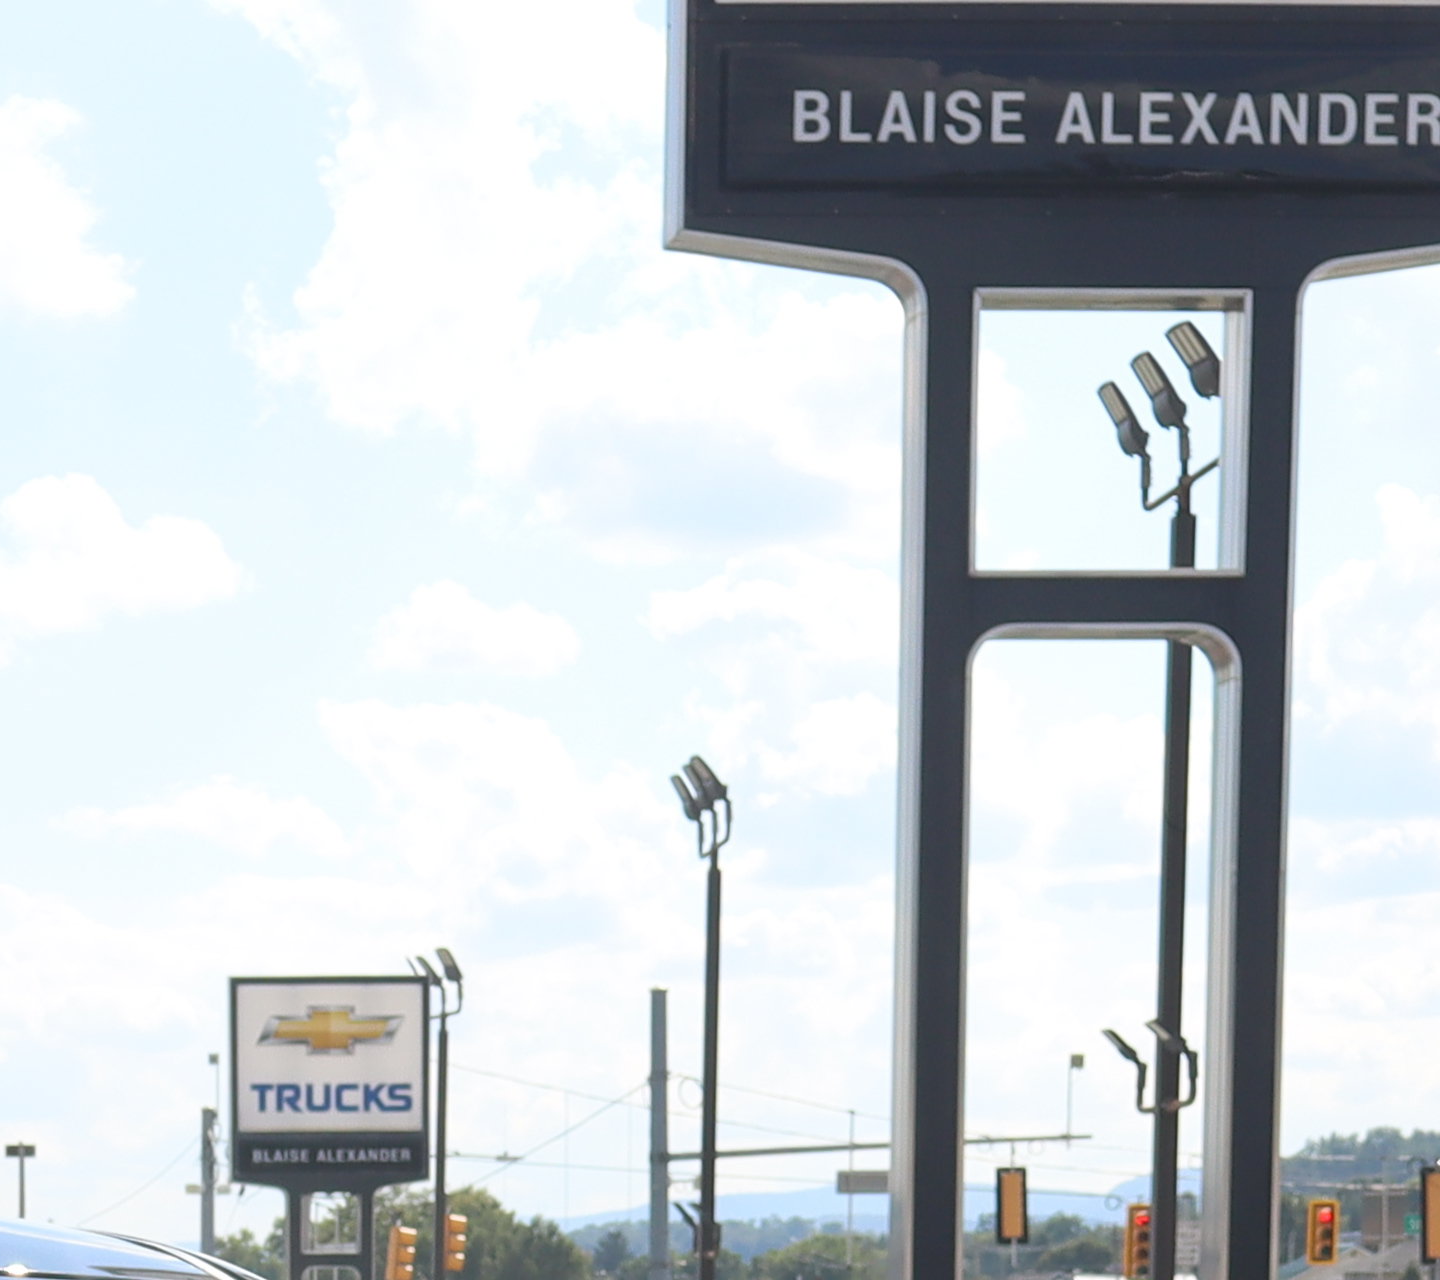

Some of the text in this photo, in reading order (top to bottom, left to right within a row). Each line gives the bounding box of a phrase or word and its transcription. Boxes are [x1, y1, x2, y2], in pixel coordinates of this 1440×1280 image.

[793, 90, 1026, 144] BLAISE
[251, 1084, 413, 1113] TRUCKS
[252, 1148, 412, 1164] BLAISE ALEXANDER
